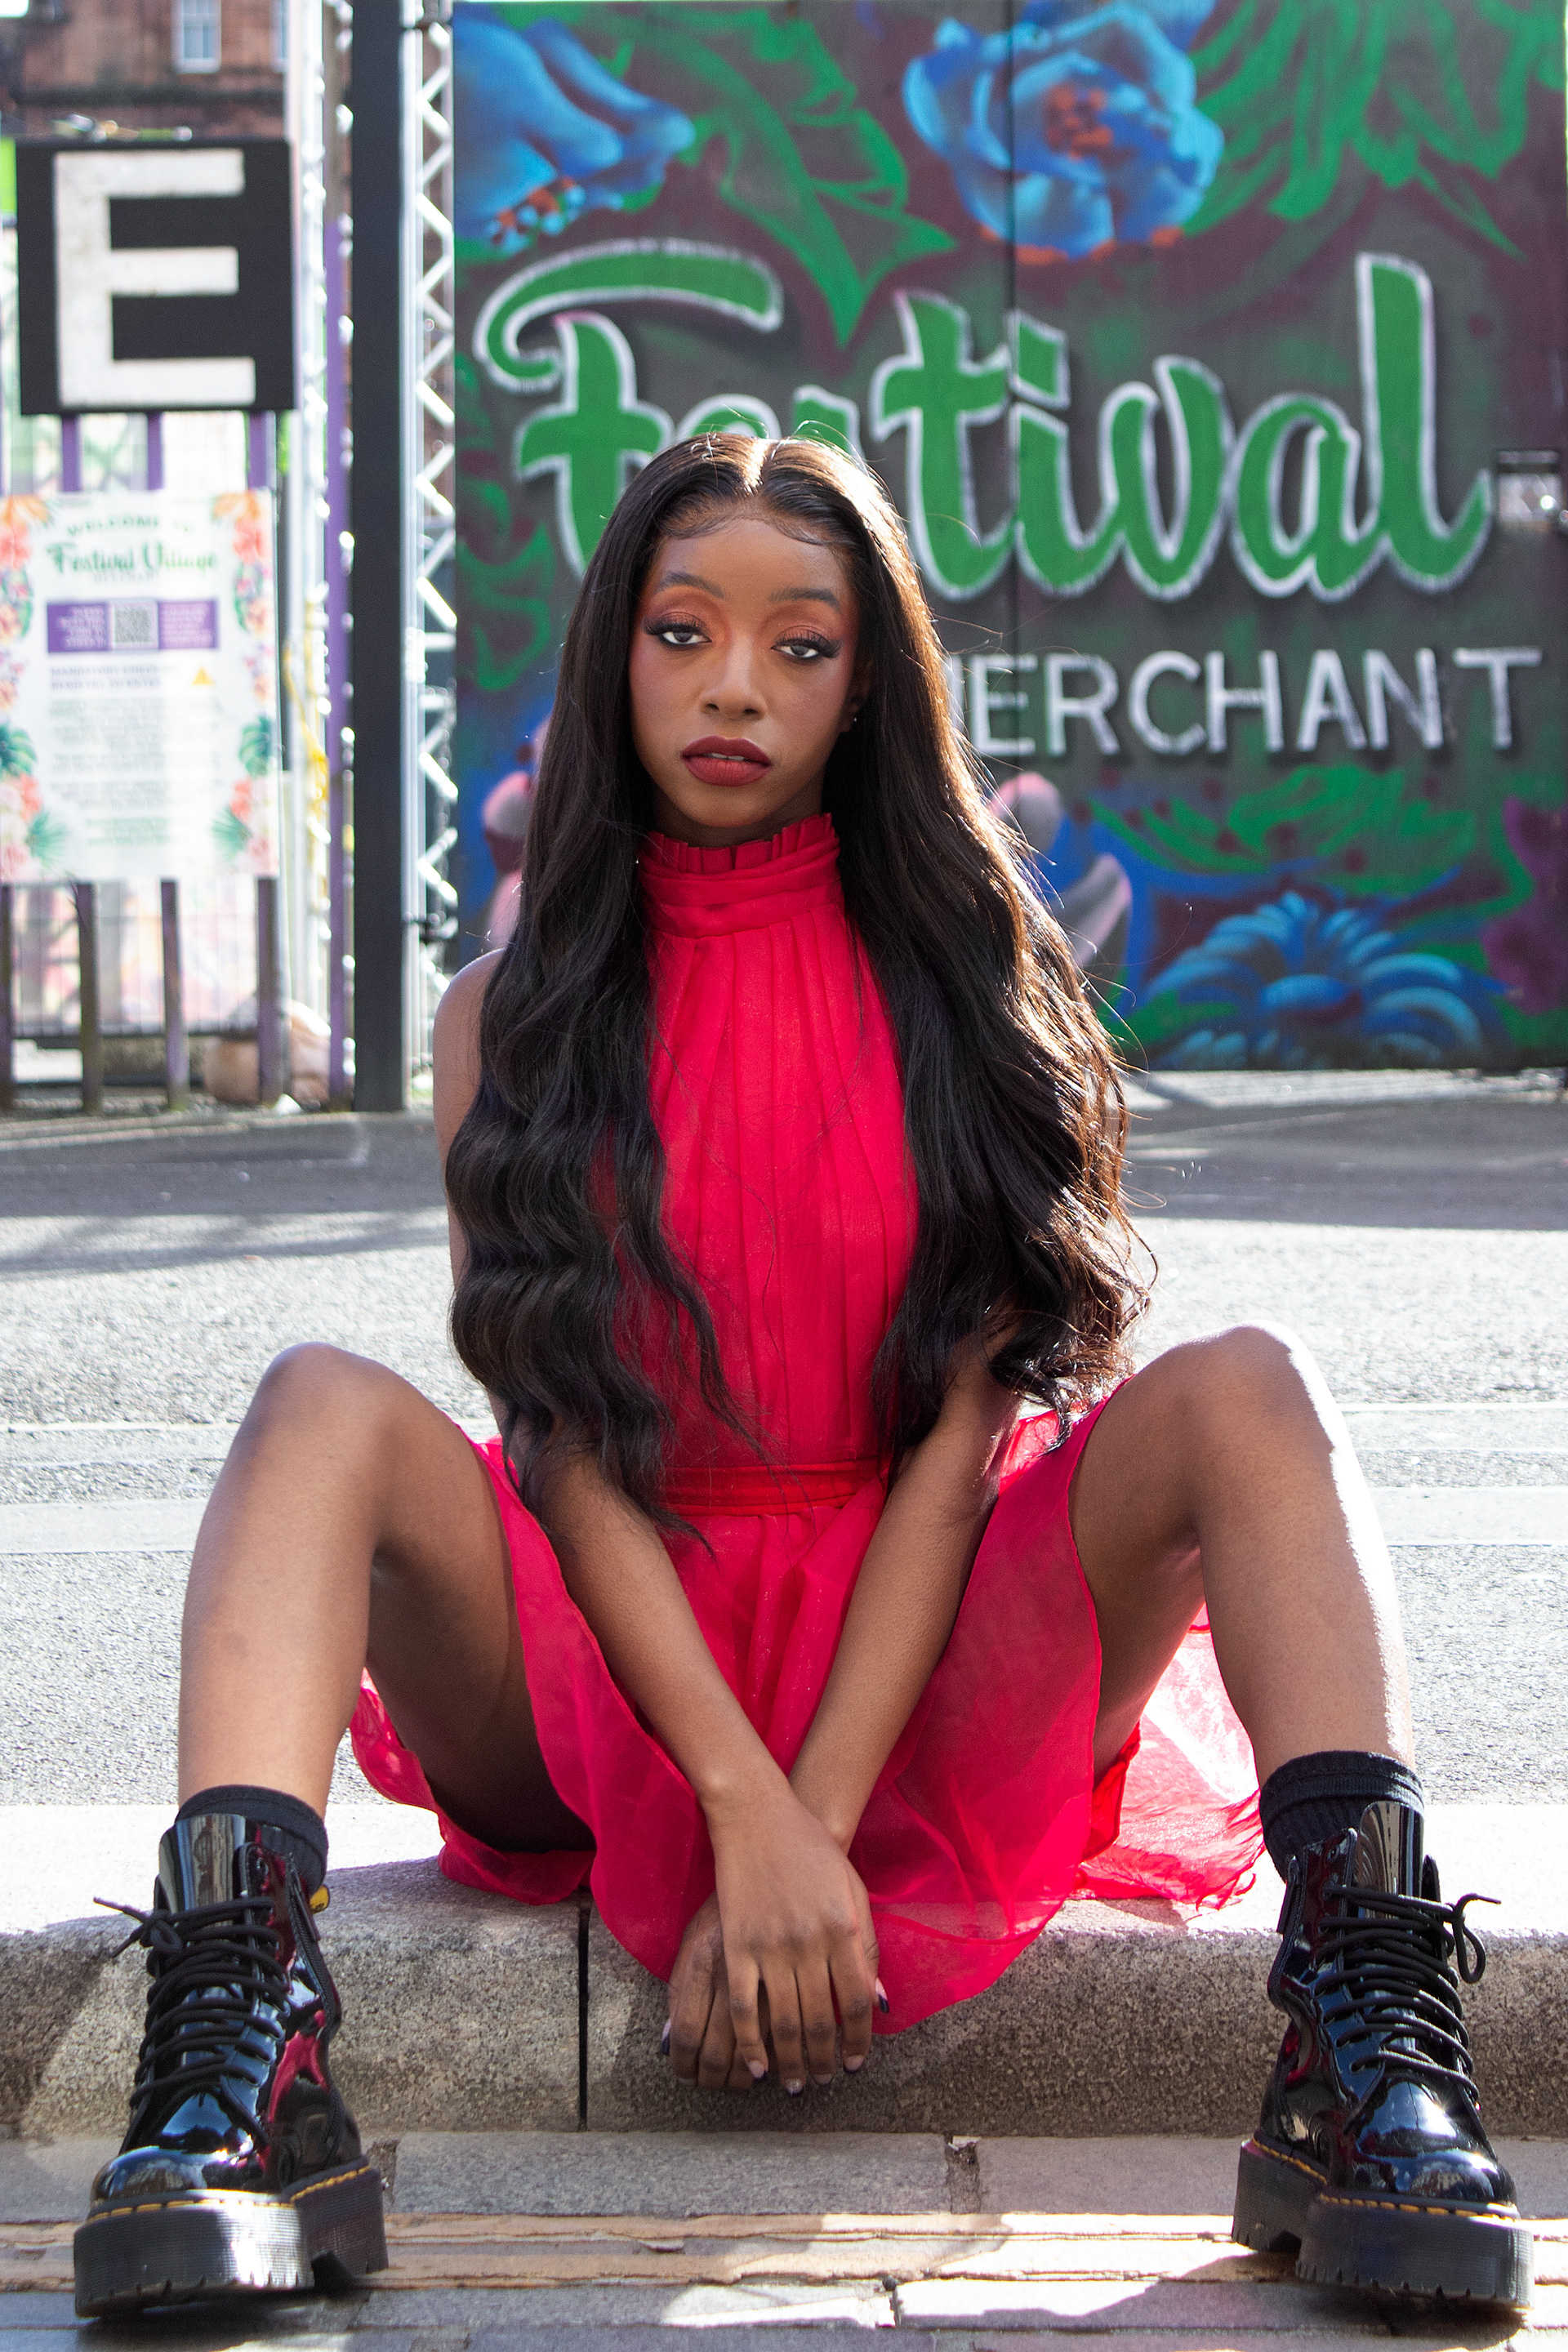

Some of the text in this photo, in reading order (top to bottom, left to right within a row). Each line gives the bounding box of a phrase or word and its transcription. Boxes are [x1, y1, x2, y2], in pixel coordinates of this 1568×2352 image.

[54, 147, 256, 407] E
[472, 238, 1494, 601] Ftival
[47, 541, 217, 577] Festival Village
[943, 648, 1542, 756] ERCHANT
